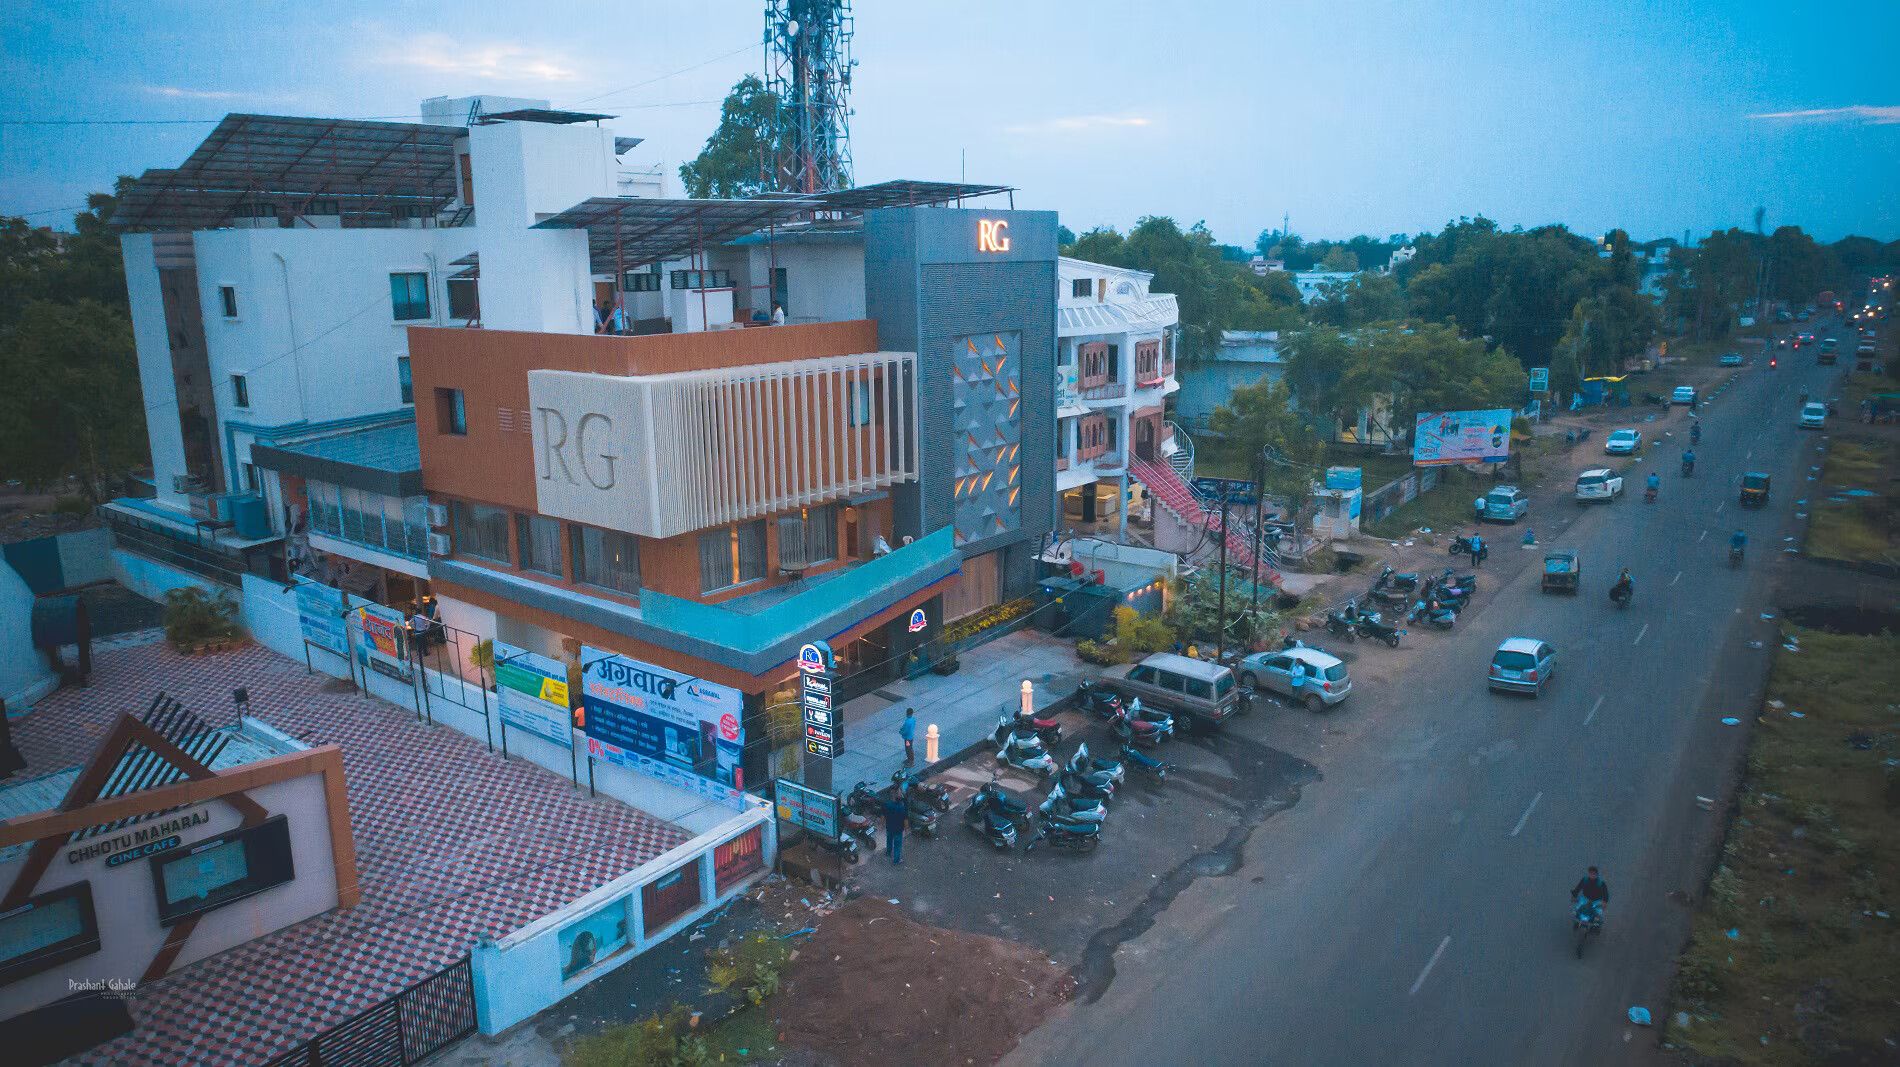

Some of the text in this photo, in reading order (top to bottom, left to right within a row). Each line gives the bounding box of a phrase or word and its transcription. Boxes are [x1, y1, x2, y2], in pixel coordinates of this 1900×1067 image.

[978, 219, 1010, 252] RG
[537, 405, 620, 490] RG
[588, 738, 605, 758] 0%
[68, 809, 210, 864] CHHOTU MAHARAJ
[109, 849, 142, 866] CINE
[143, 838, 176, 856] CAFE
